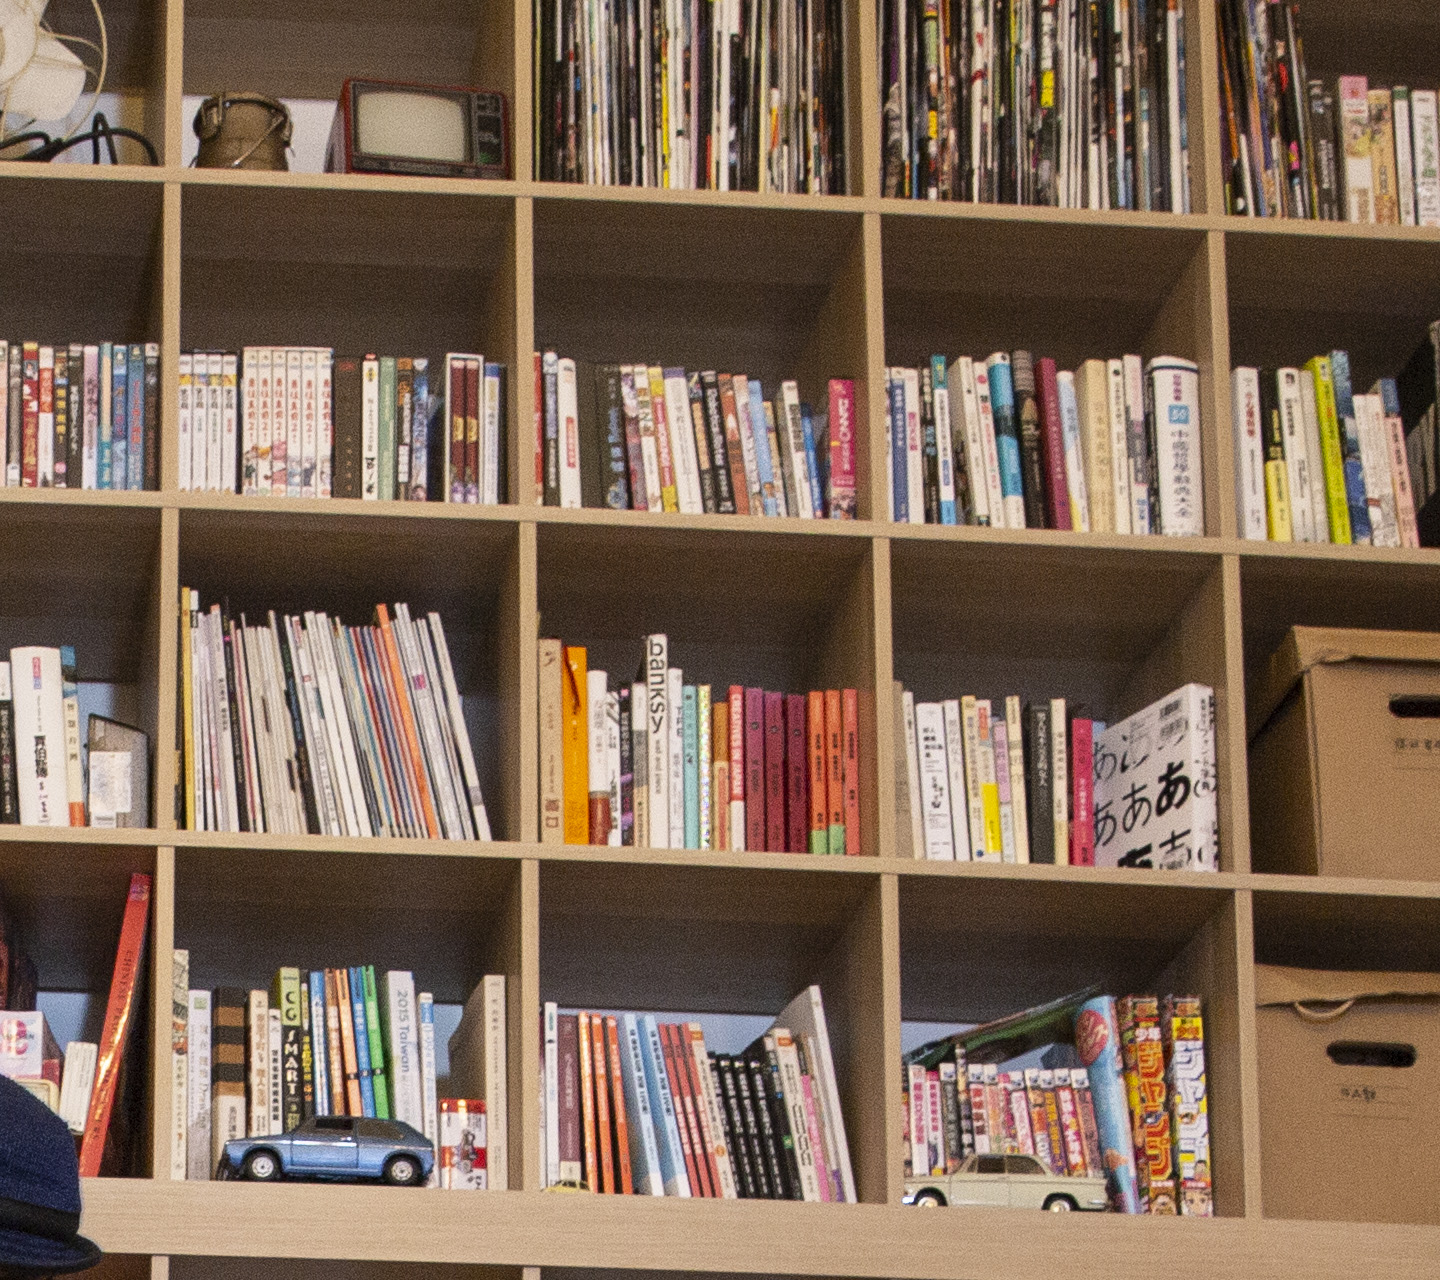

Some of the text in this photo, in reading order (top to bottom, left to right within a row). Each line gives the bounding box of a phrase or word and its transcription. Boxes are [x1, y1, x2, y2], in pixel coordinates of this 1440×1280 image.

[648, 639, 665, 734] banksy
[1167, 760, 1201, 817] あ
[397, 990, 408, 1023] 2015
[1135, 1026, 1162, 1042] 少年
